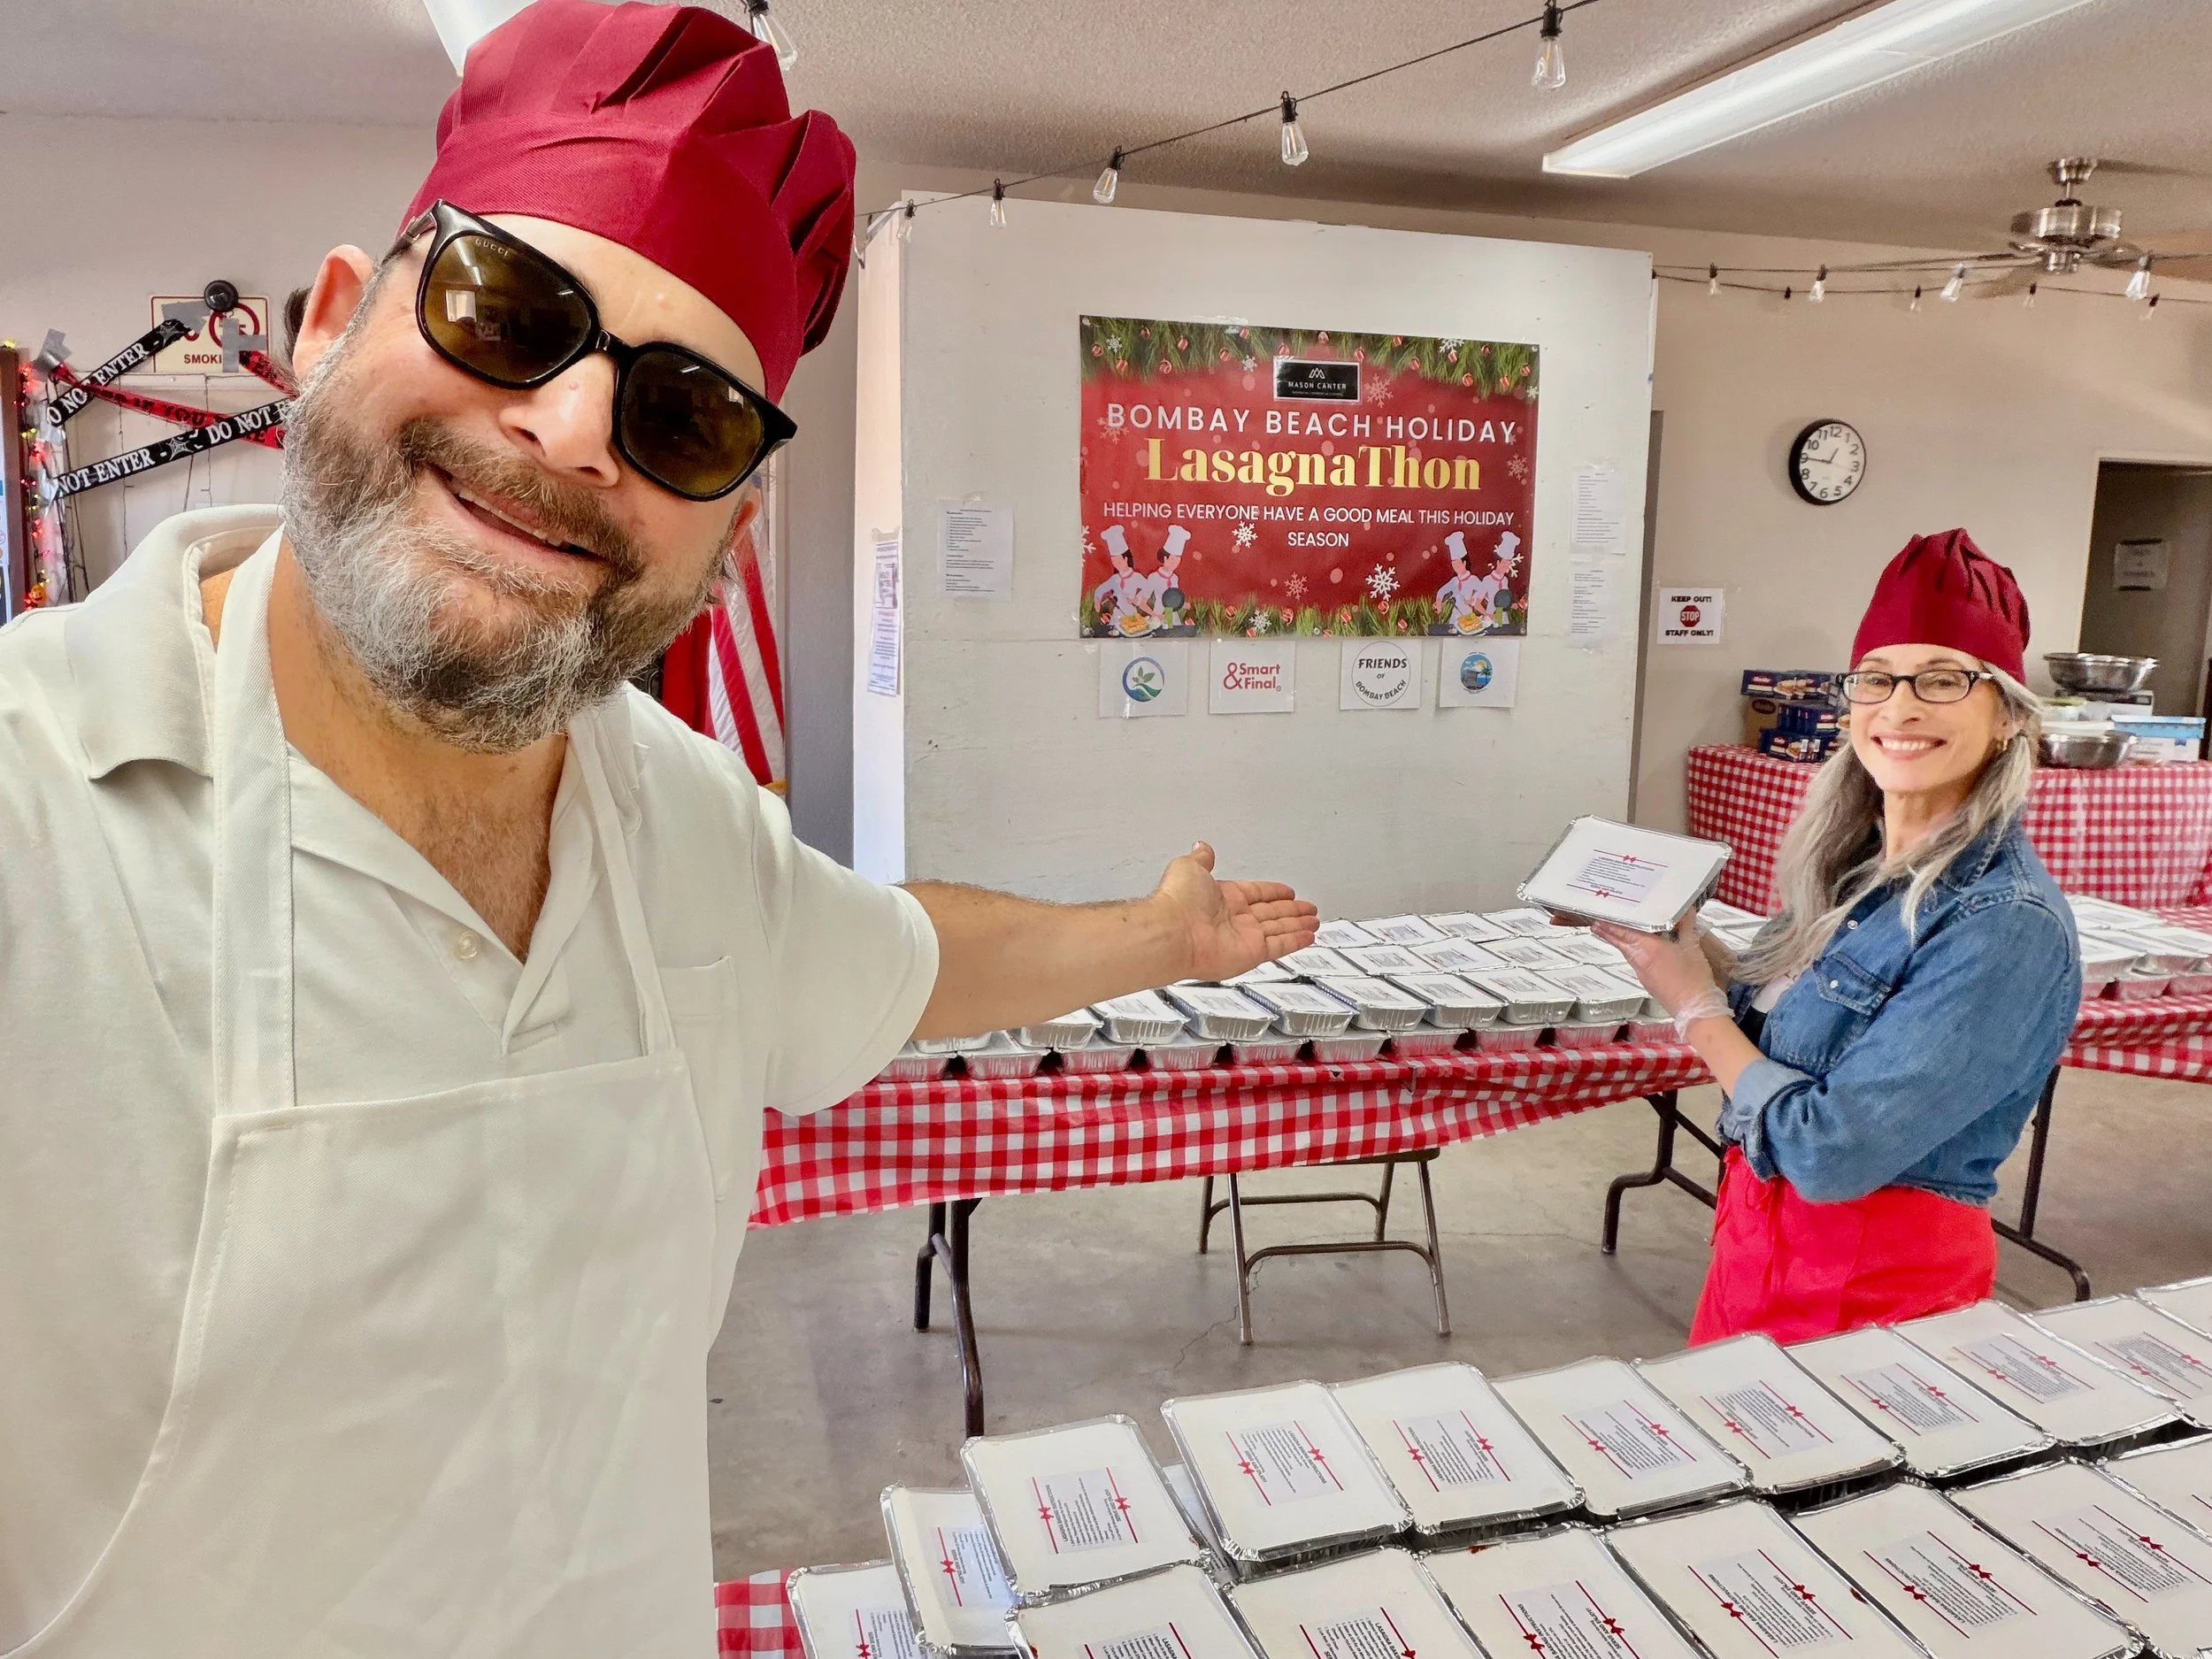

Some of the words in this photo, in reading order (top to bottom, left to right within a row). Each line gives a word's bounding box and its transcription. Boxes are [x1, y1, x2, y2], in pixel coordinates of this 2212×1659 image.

[475, 238, 509, 257] GUCCI
[93, 342, 149, 387] ENTER
[207, 421, 232, 444] DO
[234, 407, 273, 434] NOT
[1107, 403, 1250, 433] BOMBAY
[1266, 410, 1371, 438] BEACH
[1386, 416, 1516, 443] HOLIDAY
[1818, 429, 1828, 440] 11
[1830, 426, 1841, 437] 12
[1846, 433, 1850, 443] 1
[1808, 440, 1819, 450] 10
[1850, 443, 1859, 455] 2
[94, 448, 156, 483] ENTER
[1144, 437, 1481, 497] LasagnaThon
[1851, 461, 1860, 472] 3
[1801, 468, 1810, 480] 8
[1809, 481, 1817, 491] 7
[1844, 475, 1853, 486] 4
[1820, 488, 1828, 498] 6
[1833, 486, 1842, 495] 5
[1103, 502, 1171, 518] HELPING
[1177, 503, 1258, 520] EVERYONE
[1263, 506, 1304, 521] HAVE
[1309, 507, 1319, 521] A
[1324, 507, 1371, 523] GOOD
[1376, 509, 1414, 524] MEAL
[1418, 510, 1450, 525] THIS
[1454, 511, 1514, 526] HOLIDAY
[1287, 532, 1349, 548] SEASON
[1681, 611, 1700, 621] STOP
[1240, 663, 1280, 675] Smart
[1358, 658, 1407, 669] FRIENDS
[1224, 662, 1242, 690] &
[1356, 680, 1384, 700] BOMBAY
[1384, 680, 1406, 699] BEACH
